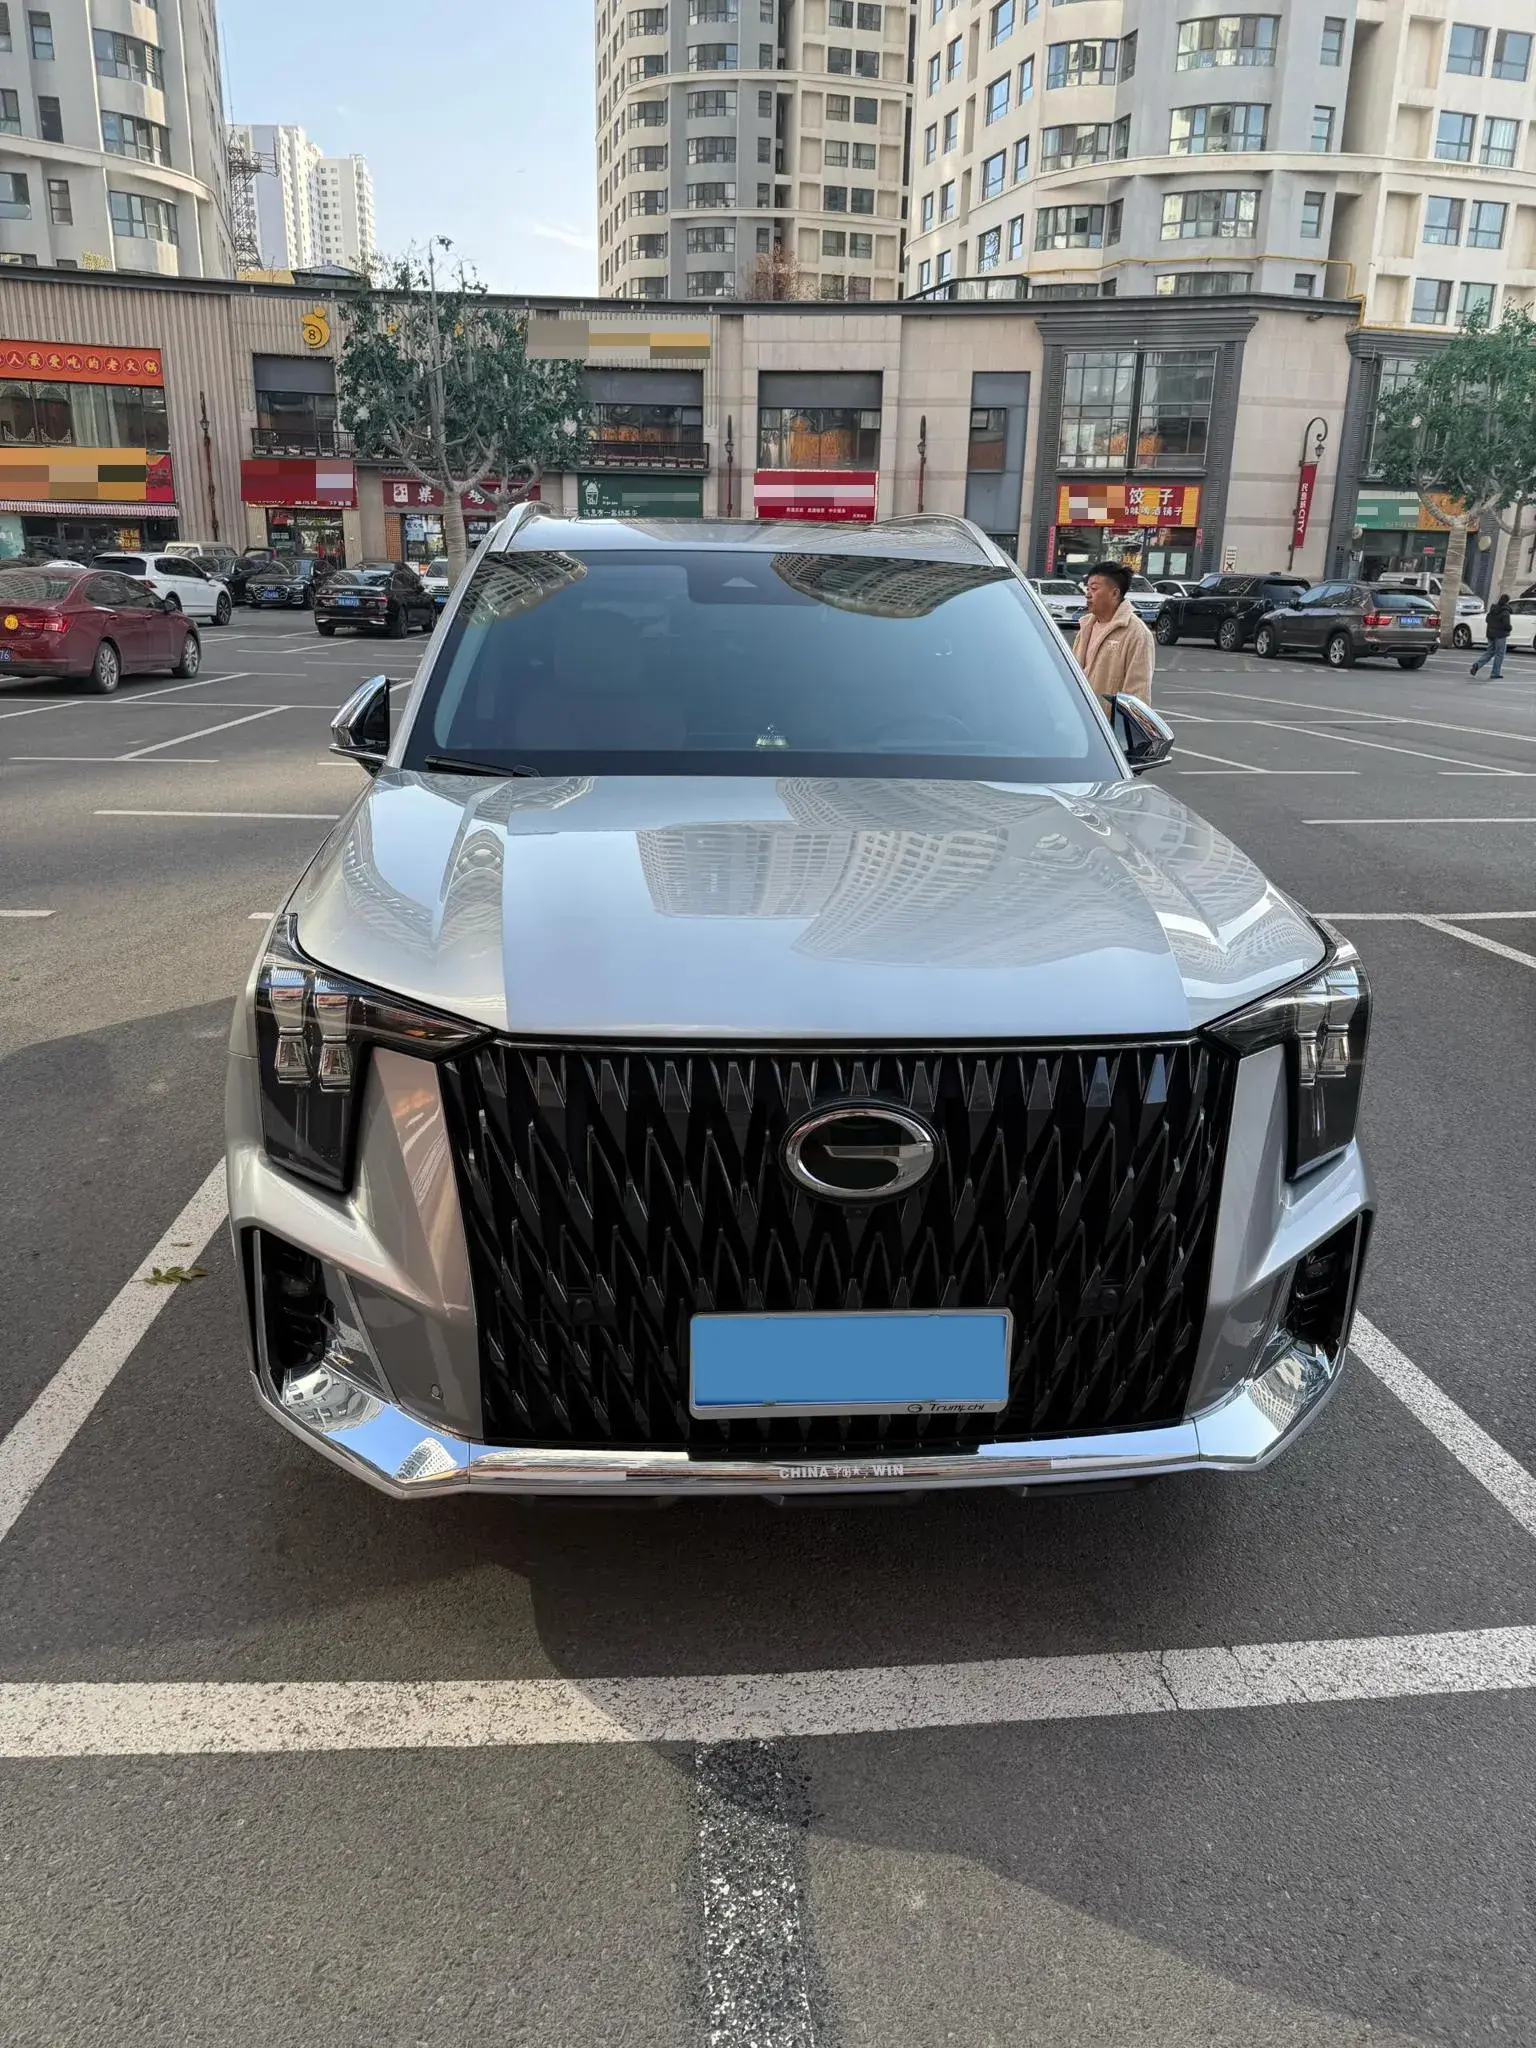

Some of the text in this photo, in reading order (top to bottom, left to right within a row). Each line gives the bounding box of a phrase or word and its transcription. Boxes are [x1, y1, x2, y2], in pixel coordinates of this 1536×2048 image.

[0, 353, 158, 373] 人最爱吃的老火锅
[1129, 487, 1174, 505] 饺子
[779, 1465, 829, 1479] CHINA
[872, 1463, 904, 1476] WIN
